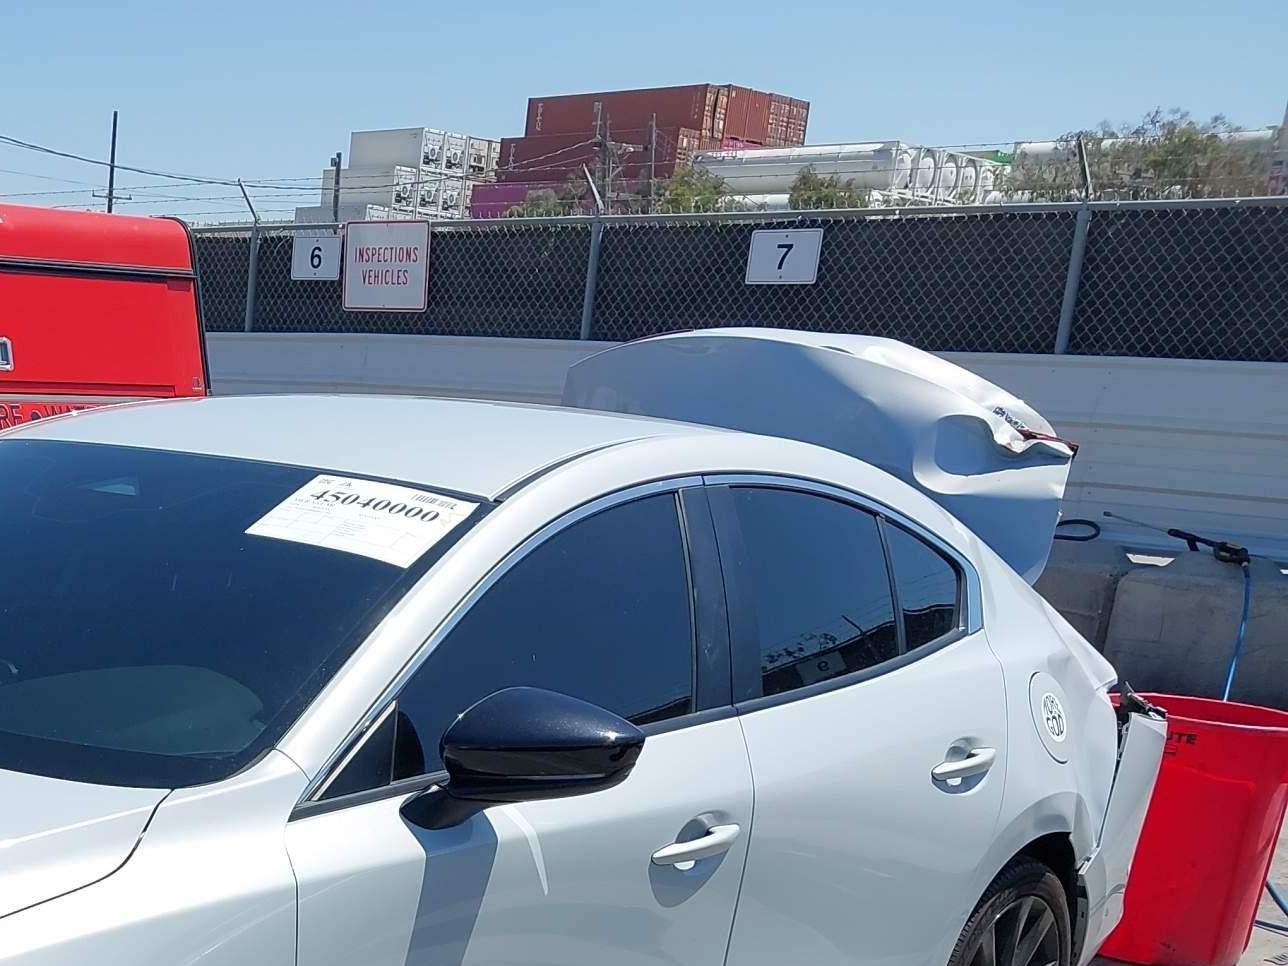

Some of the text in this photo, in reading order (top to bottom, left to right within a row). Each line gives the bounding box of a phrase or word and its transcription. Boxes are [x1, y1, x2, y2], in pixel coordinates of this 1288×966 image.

[310, 246, 323, 269] 6
[354, 247, 419, 263] INSPECTIONS
[777, 243, 794, 270] 7
[361, 269, 409, 285] VEHICLES
[310, 489, 440, 522] 45040000
